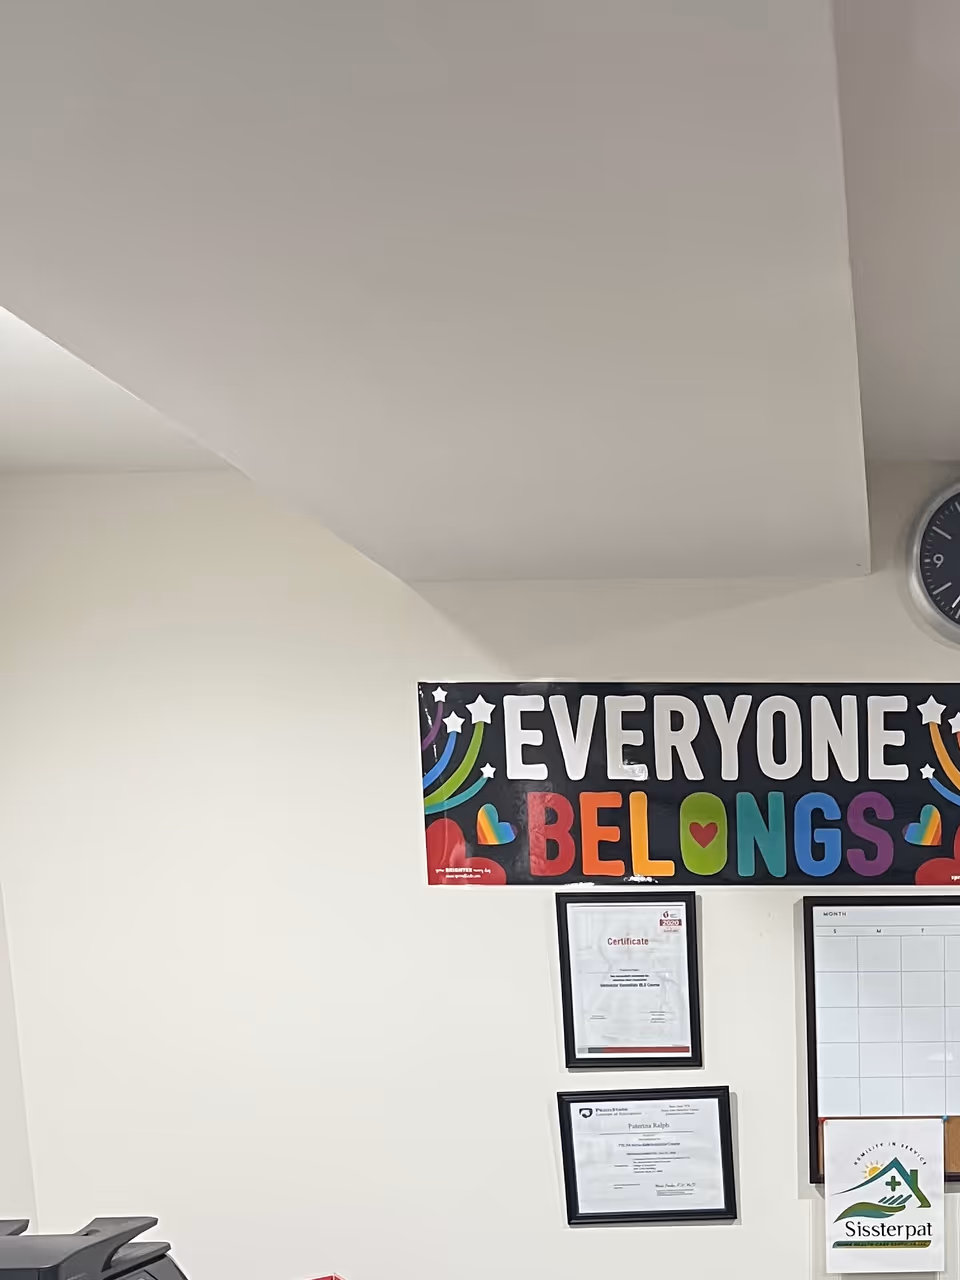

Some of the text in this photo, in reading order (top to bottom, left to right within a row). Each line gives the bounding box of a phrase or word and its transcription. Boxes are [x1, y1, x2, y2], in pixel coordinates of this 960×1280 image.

[933, 554, 944, 568] 9
[503, 694, 910, 783] EVERYONE
[526, 790, 895, 878] BELONGS
[607, 937, 649, 946] Certificate
[853, 1142, 884, 1166] HUMILITY
[900, 1142, 927, 1166] SERVICE
[845, 1220, 933, 1240] Sissterpat
